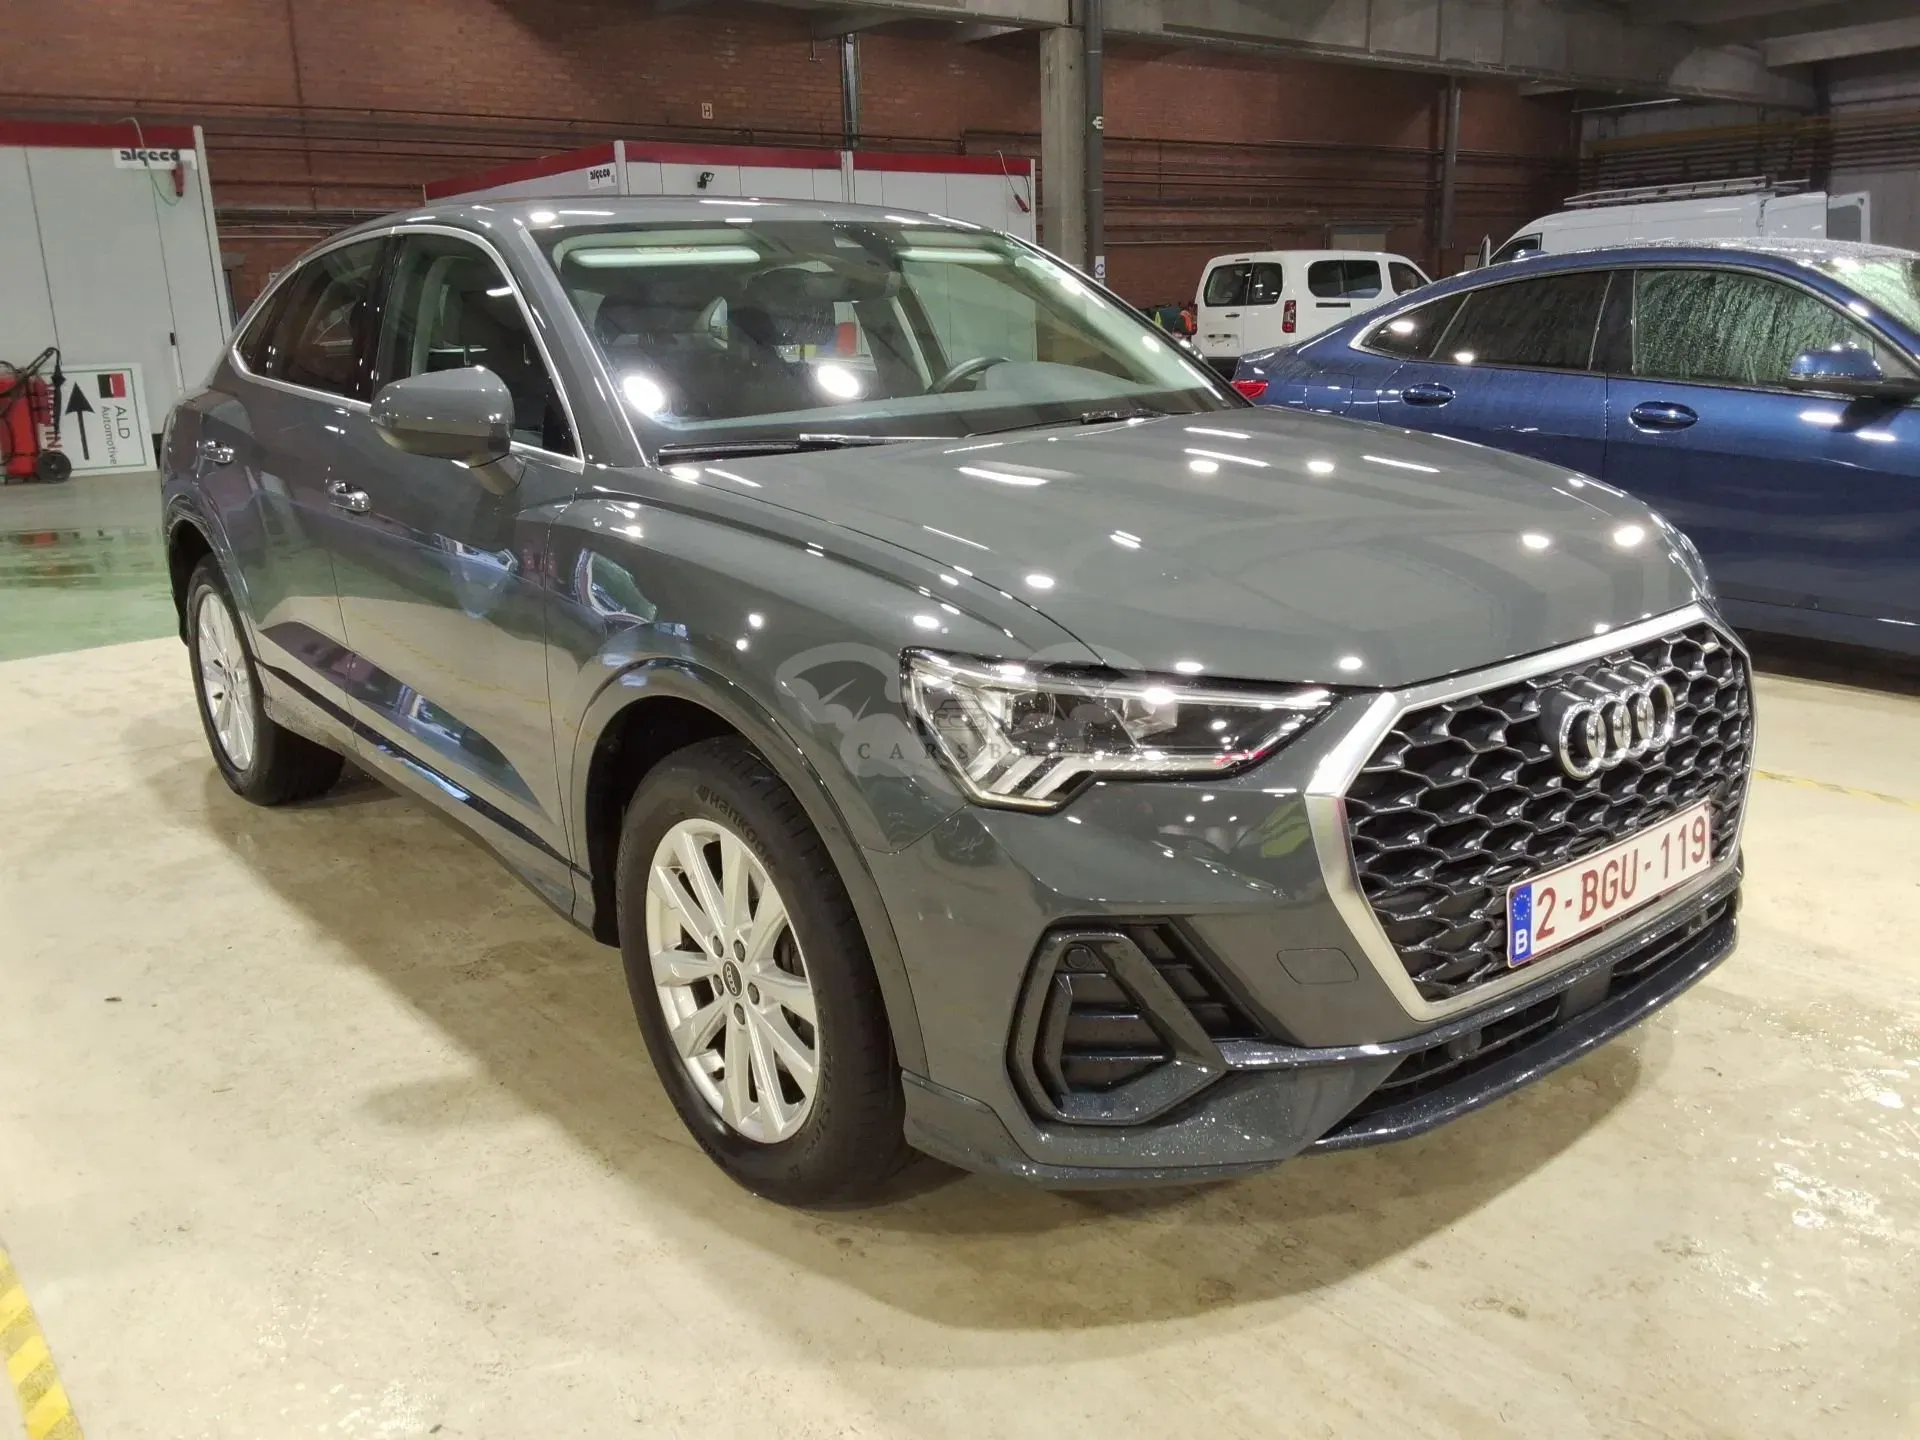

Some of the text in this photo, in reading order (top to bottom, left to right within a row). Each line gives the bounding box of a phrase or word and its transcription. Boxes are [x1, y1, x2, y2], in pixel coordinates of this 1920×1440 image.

[101, 406, 117, 465] Automotive
[115, 406, 130, 439] ALD
[1535, 815, 1706, 941] 2-BGU-119
[1515, 928, 1527, 955] B
